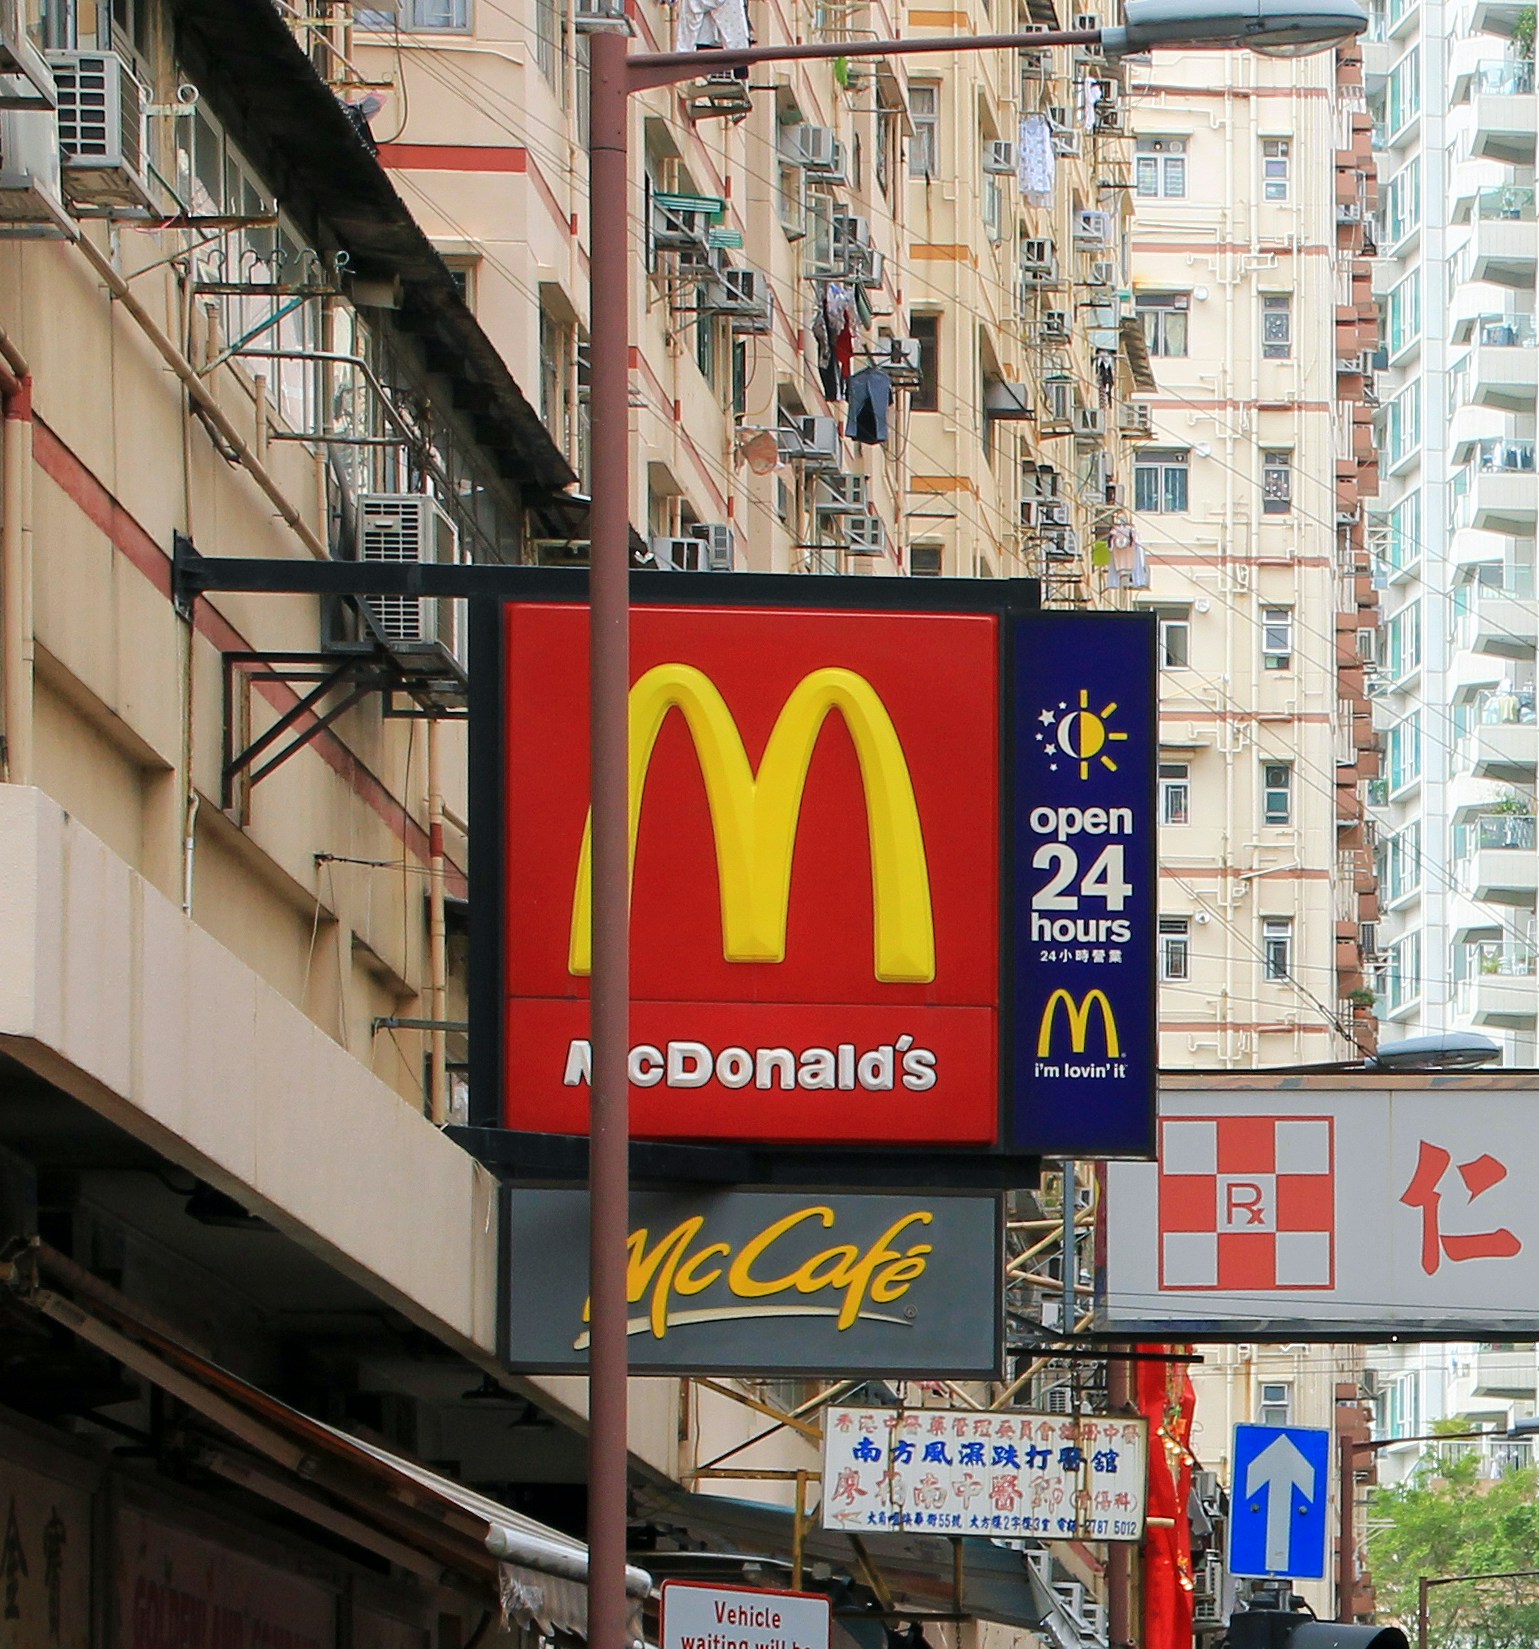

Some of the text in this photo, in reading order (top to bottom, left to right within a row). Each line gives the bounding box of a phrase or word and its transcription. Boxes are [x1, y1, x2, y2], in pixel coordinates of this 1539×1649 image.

[1030, 804, 1132, 839] open
[1031, 844, 1132, 912] 24
[1031, 913, 1131, 944] hours
[1040, 949, 1122, 964] 24小時營業
[1035, 1062, 1127, 1078] i'm lovin' it
[582, 1206, 933, 1339] McCafé
[715, 1600, 781, 1629] Vehicle
